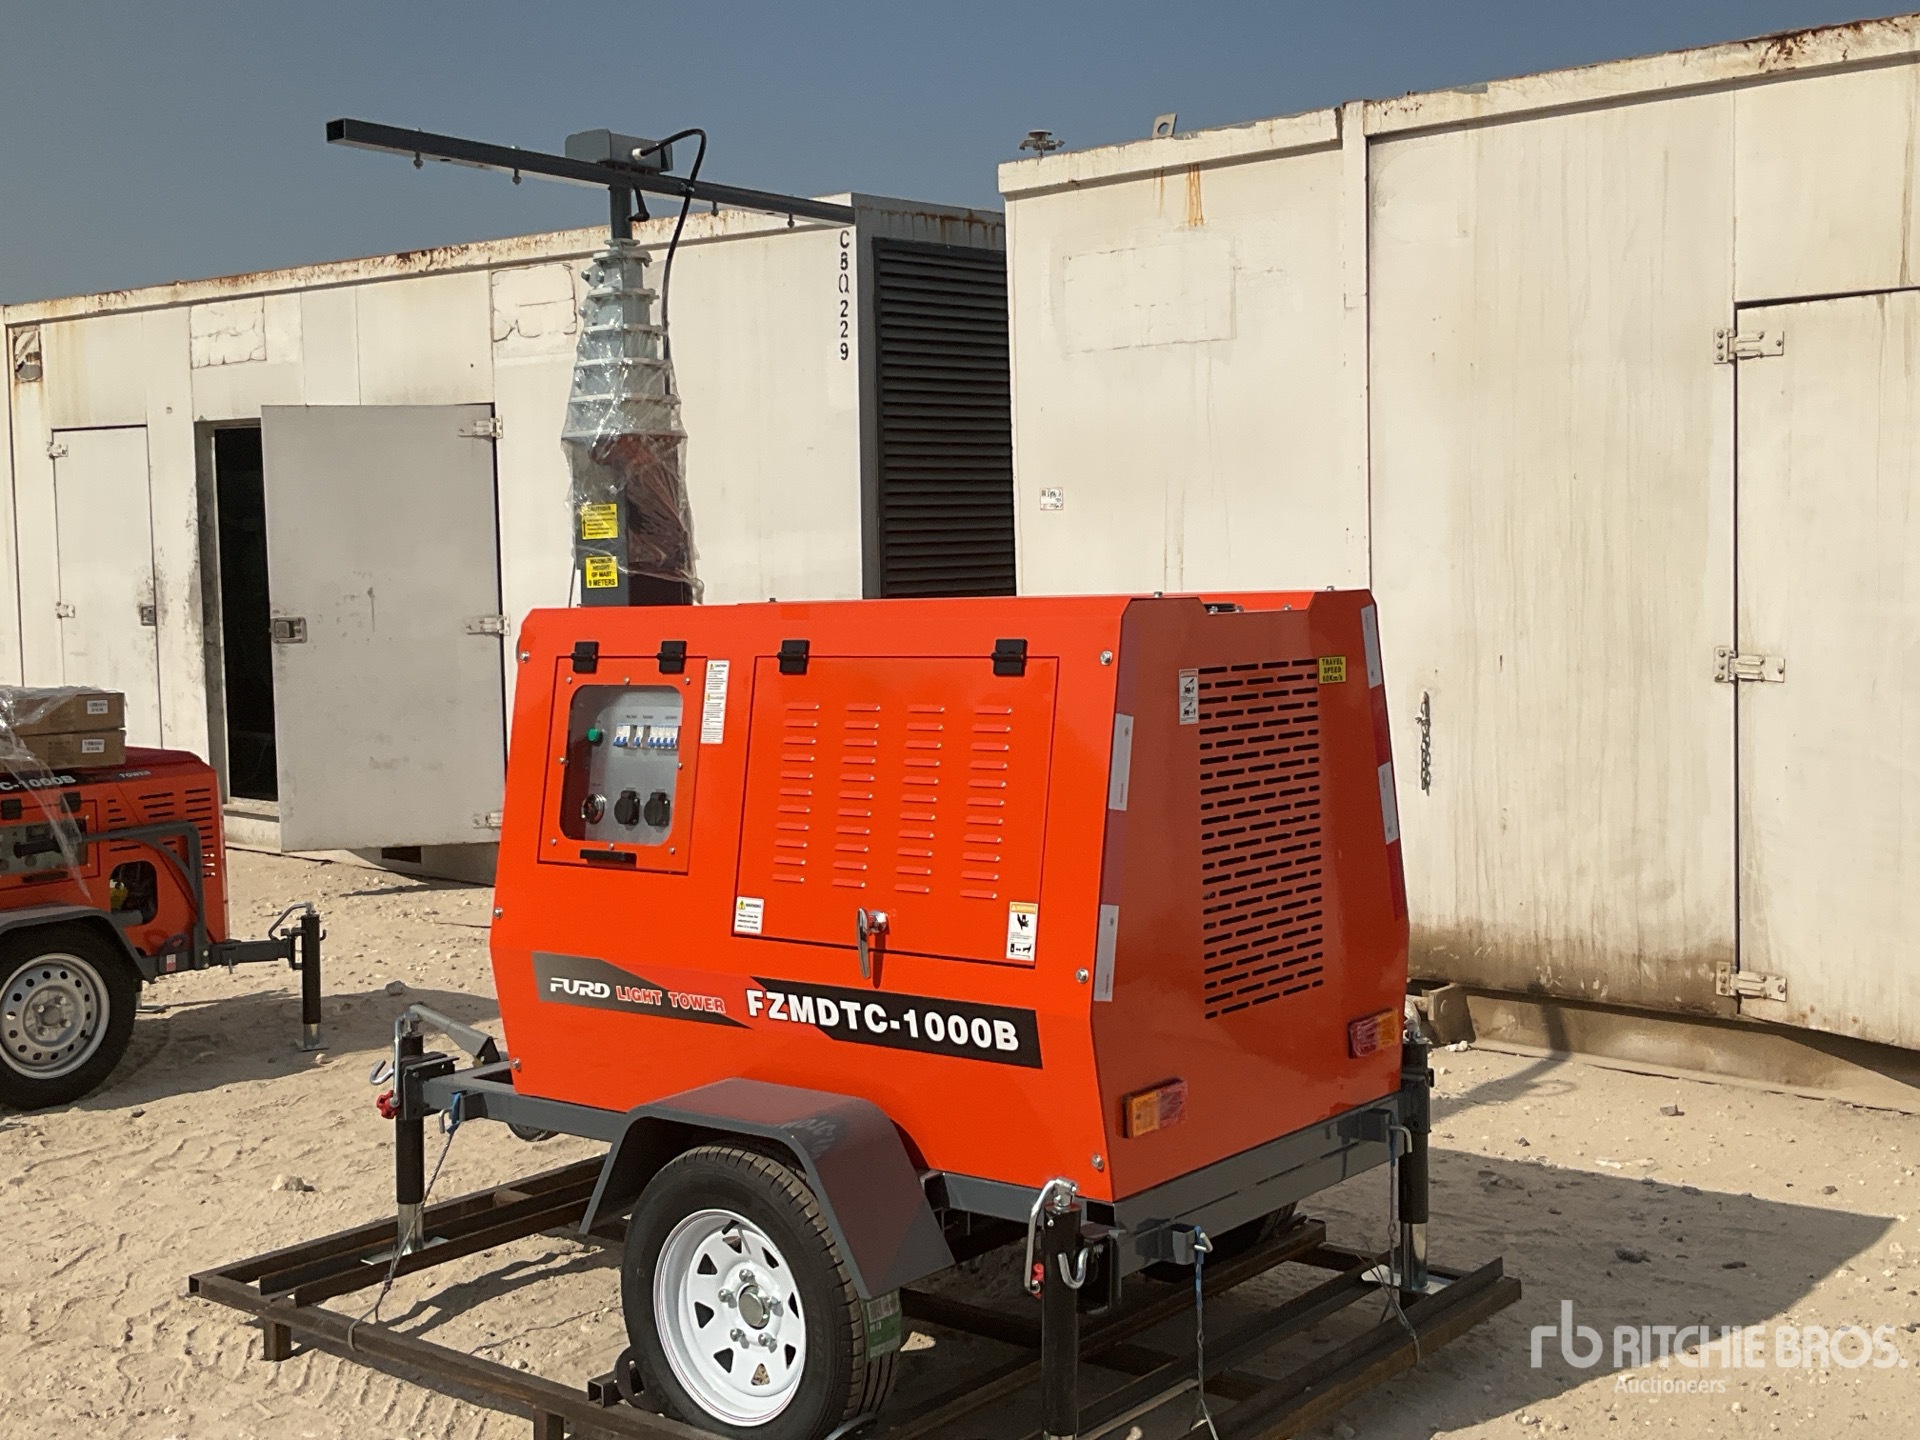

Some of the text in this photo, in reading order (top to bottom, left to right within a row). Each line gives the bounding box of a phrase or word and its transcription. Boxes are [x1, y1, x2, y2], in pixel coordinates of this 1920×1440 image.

[593, 579, 616, 587] METERS
[1321, 657, 1343, 665] TRAVEL
[1323, 666, 1341, 674] SPEED
[550, 977, 726, 1014] FURD LIGHT TOWER
[746, 988, 1020, 1051] FZMDTC-1000B
